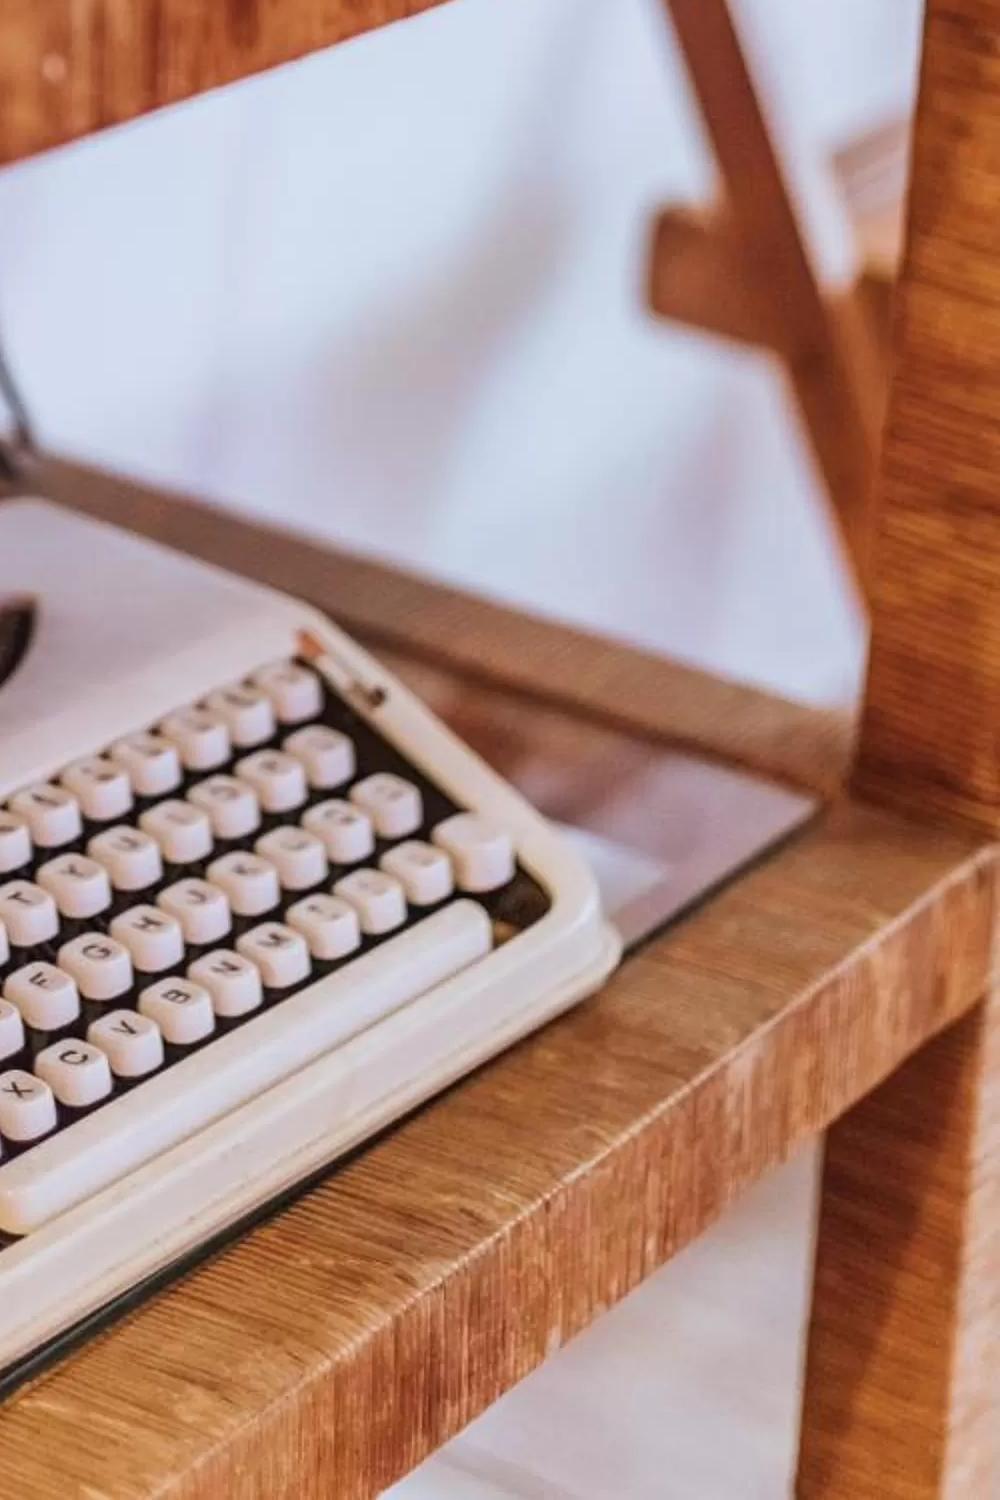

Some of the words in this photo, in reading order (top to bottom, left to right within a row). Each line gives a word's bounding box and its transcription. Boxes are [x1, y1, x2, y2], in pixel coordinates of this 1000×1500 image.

[29, 971, 49, 989] F
[82, 944, 112, 959] G
[131, 915, 162, 930] H
[2, 1081, 34, 1099] X
[58, 1050, 90, 1067] C
[111, 1020, 138, 1036] V
[160, 989, 192, 1004] B
[208, 960, 242, 977] N
